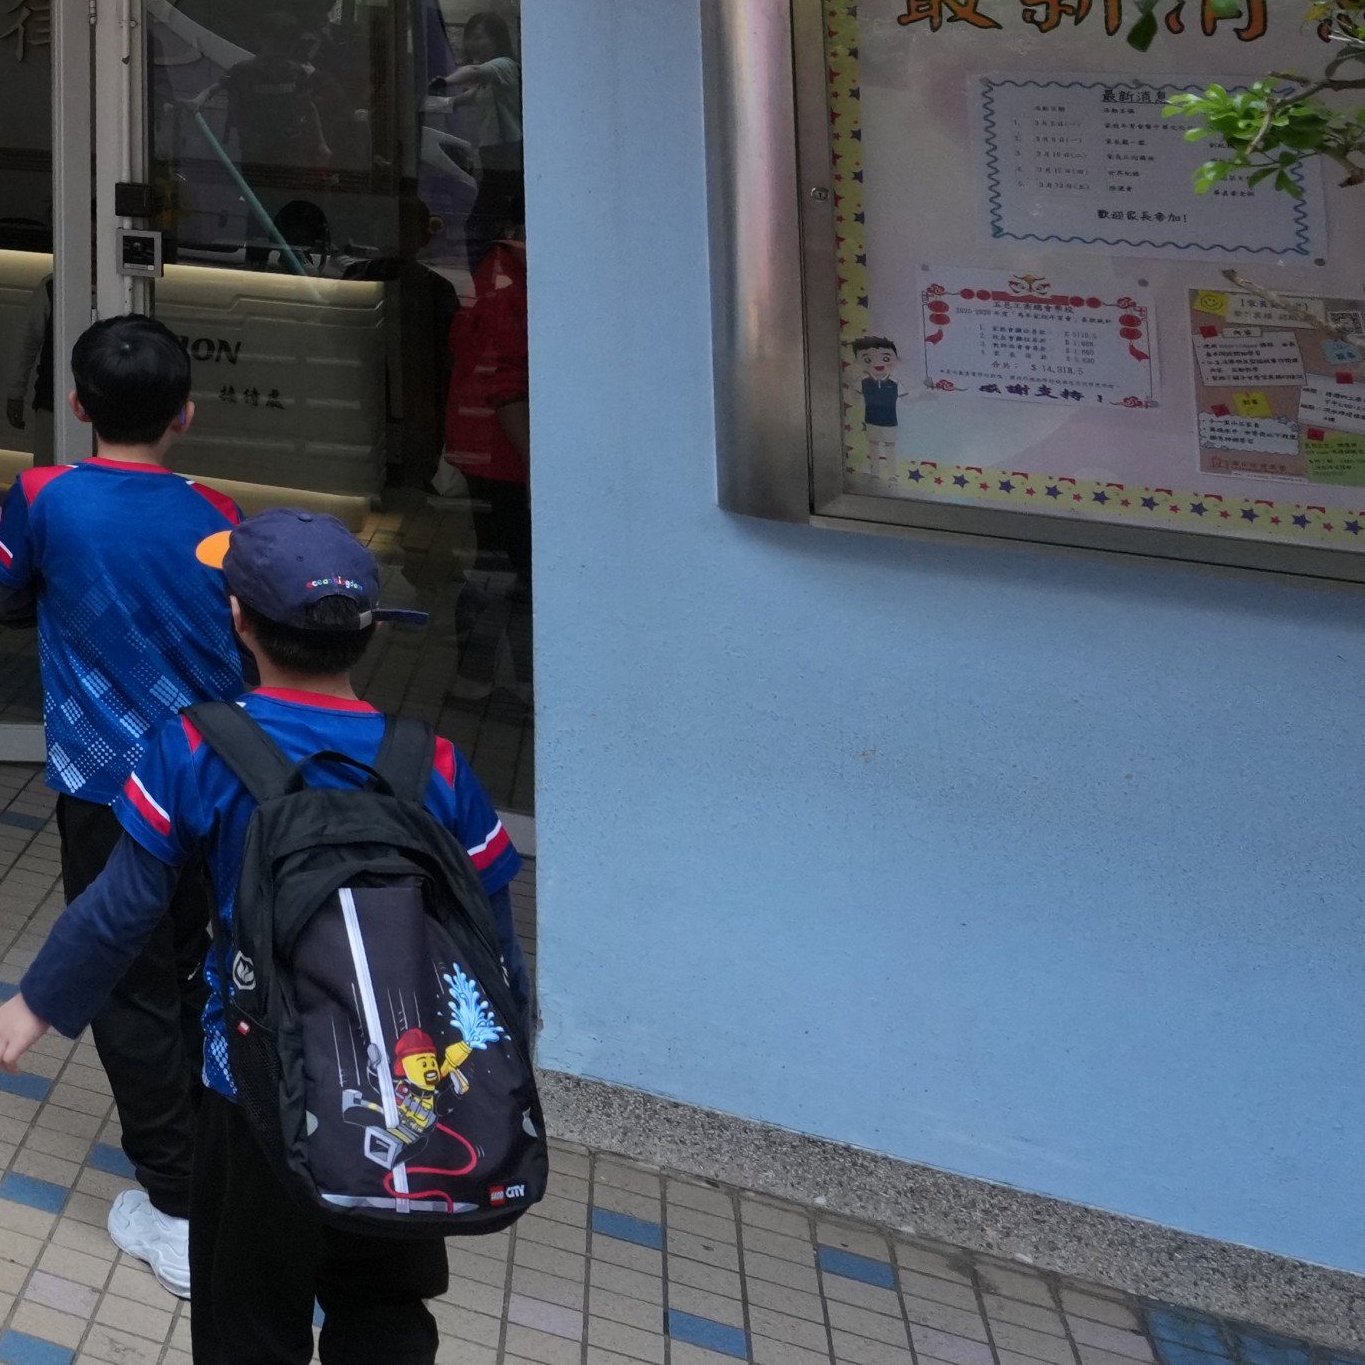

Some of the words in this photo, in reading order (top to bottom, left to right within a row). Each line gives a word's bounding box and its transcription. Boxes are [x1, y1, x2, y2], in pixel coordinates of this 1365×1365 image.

[1102, 90, 1168, 103] 最新消息
[505, 1184, 526, 1199] CITY
